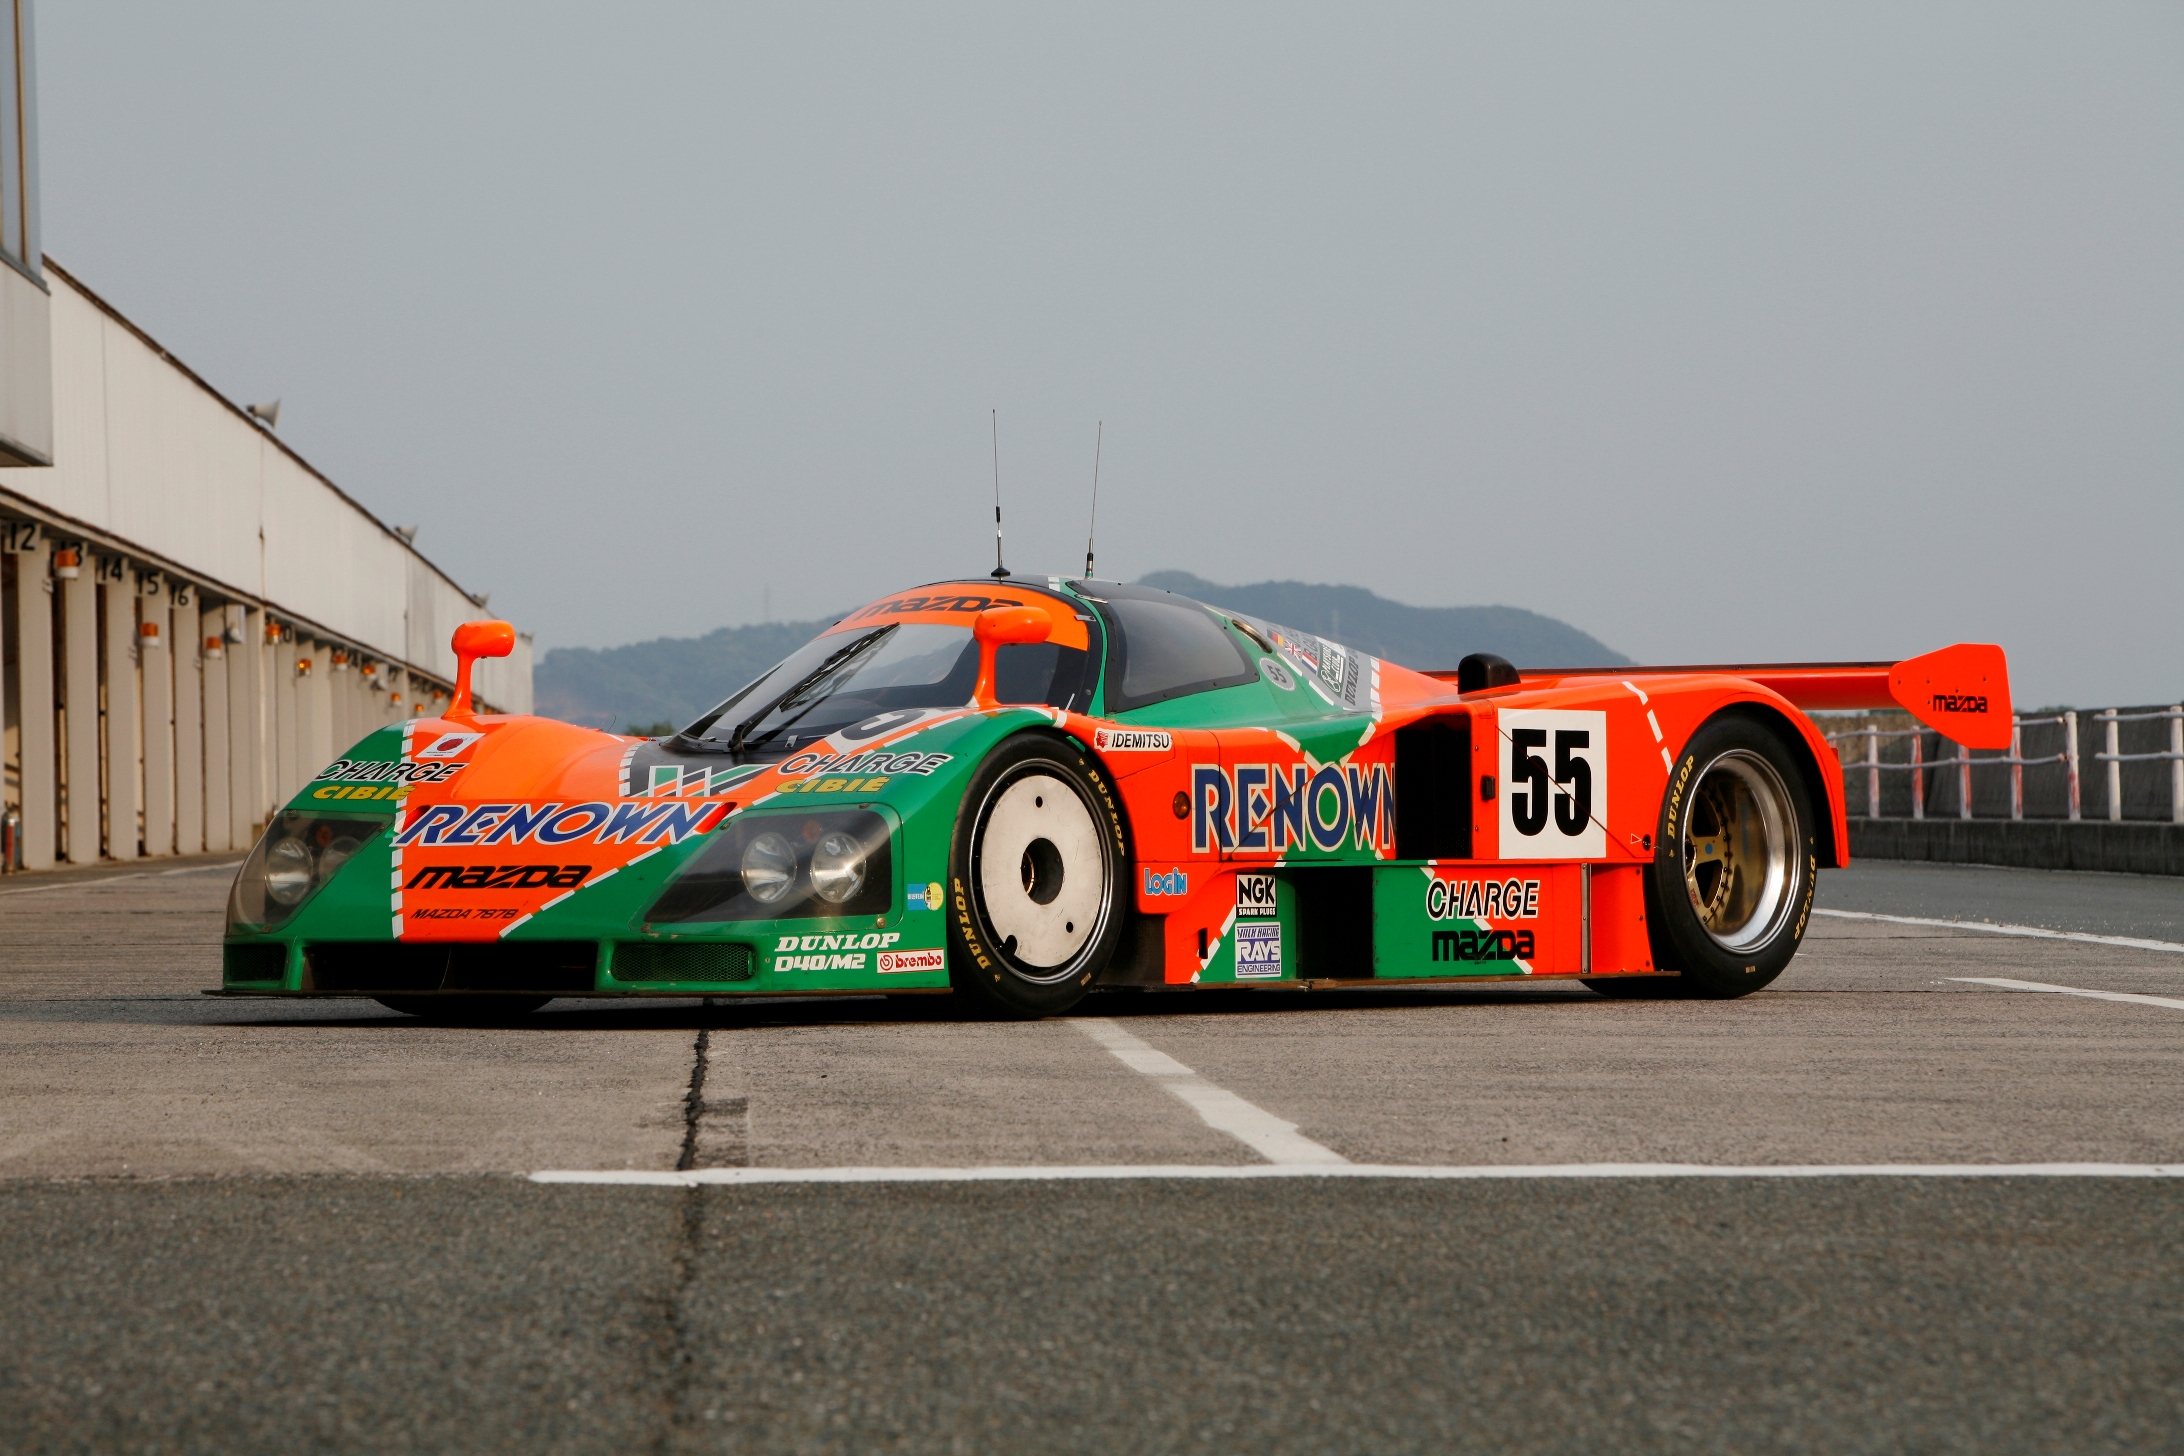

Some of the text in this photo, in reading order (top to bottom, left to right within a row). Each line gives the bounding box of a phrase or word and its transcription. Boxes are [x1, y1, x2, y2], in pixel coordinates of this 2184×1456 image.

[10, 522, 36, 551] 12
[102, 556, 122, 581] 14
[138, 571, 159, 596] 15
[171, 583, 189, 606] 16
[1267, 664, 1287, 684] 55
[1344, 655, 1359, 706] DUNLOP
[1932, 694, 1988, 713] mazda
[1111, 733, 1170, 750] IDEMITSU
[312, 759, 471, 784] CHARGE
[776, 751, 956, 776] CHARGE
[1511, 728, 1592, 837] 55
[1191, 761, 1396, 854] RENOWN
[1667, 754, 1694, 840] DUNLOP
[389, 801, 724, 847] RENOWN
[1088, 769, 1125, 857] DUNLOP
[403, 865, 593, 890] mazda
[1238, 877, 1276, 906] NGK
[1426, 877, 1540, 922] CHARGE
[1794, 854, 1816, 940] DUNLOP
[410, 909, 520, 920] MAZDA 787B
[954, 877, 992, 970] DUNLOP
[1238, 907, 1276, 916] SPARK PLUGS
[773, 932, 901, 953] DUNLOP
[1237, 927, 1280, 939] VOLK RACING
[1431, 929, 1536, 962] mazda
[773, 953, 867, 973] D40/M2
[895, 952, 942, 969] brembo
[1237, 940, 1281, 962] RAYS
[1237, 963, 1281, 973] ENGINEERING
